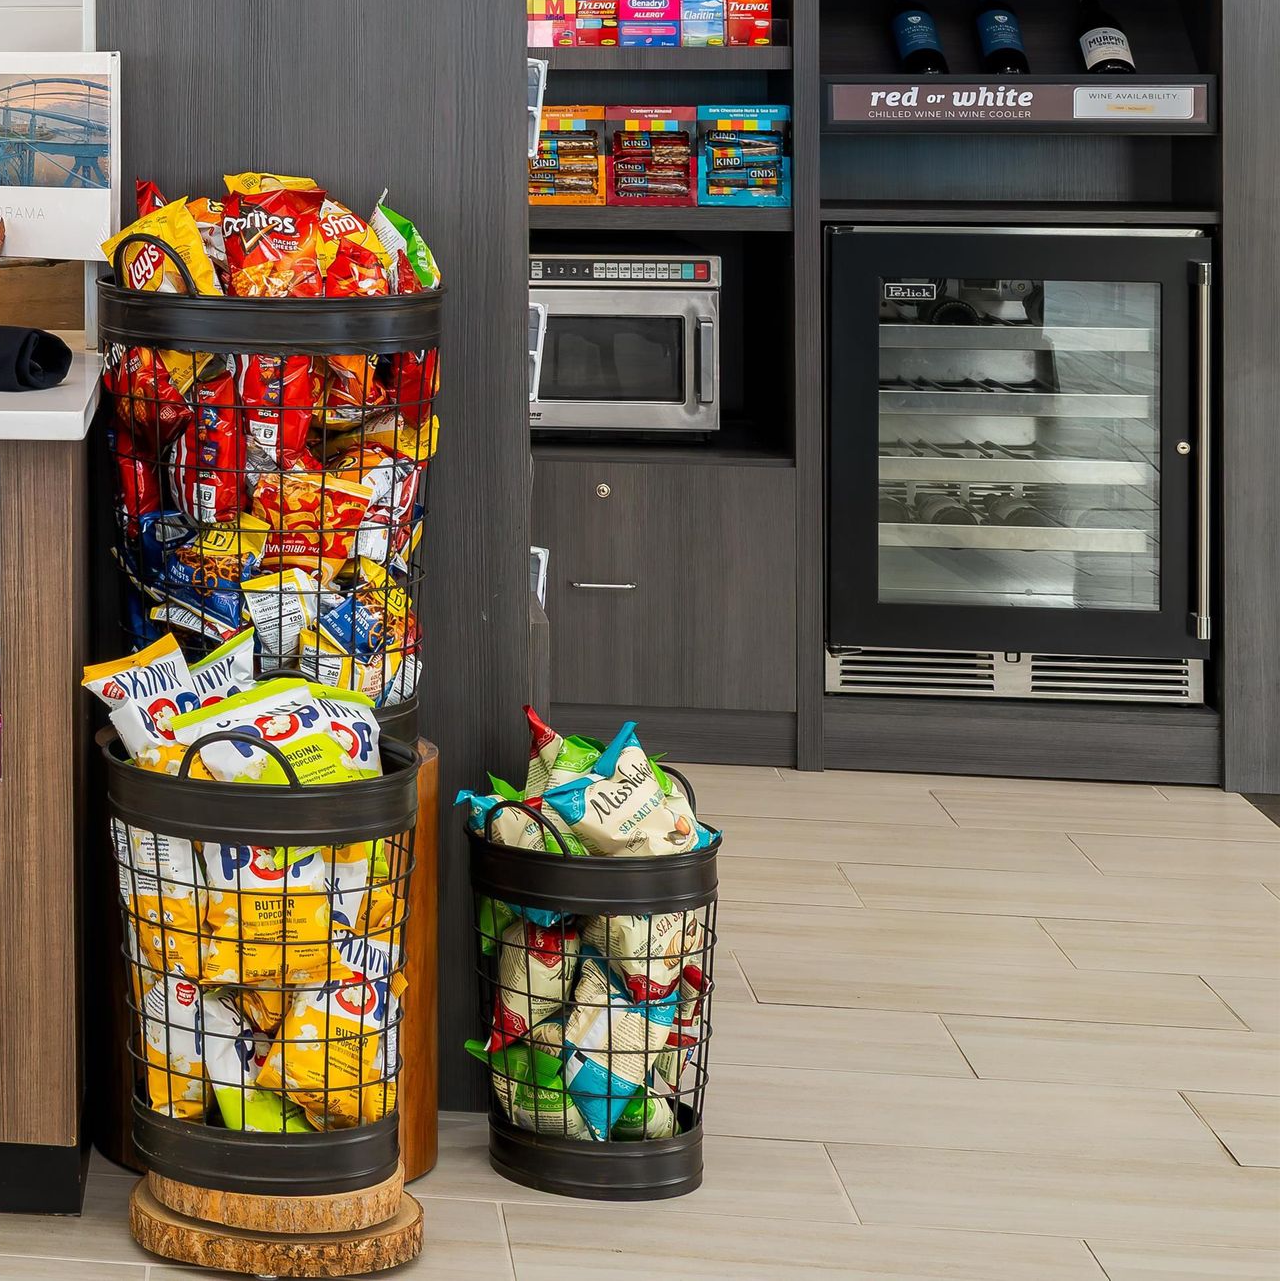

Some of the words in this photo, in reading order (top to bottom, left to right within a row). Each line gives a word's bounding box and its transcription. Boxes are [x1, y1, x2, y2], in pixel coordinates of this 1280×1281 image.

[578, 1, 615, 9] TYLENOL
[631, 0, 666, 9] Benadryl
[730, 2, 768, 11] TYLENOL
[684, 11, 714, 19] Claritin
[1088, 36, 1124, 48] MURPHY
[870, 86, 918, 107] red
[926, 92, 944, 104] or
[953, 86, 1033, 107] white
[533, 159, 556, 167] KIND
[223, 211, 295, 238] Doritos
[129, 244, 161, 289] Lay's
[888, 285, 933, 300] Perlick
[287, 744, 323, 760] RIGINAL
[590, 782, 632, 824] Miss
[619, 818, 635, 834] SEA
[633, 804, 652, 822] SALT
[255, 900, 295, 910] BUTTR
[656, 919, 673, 937] SEA
